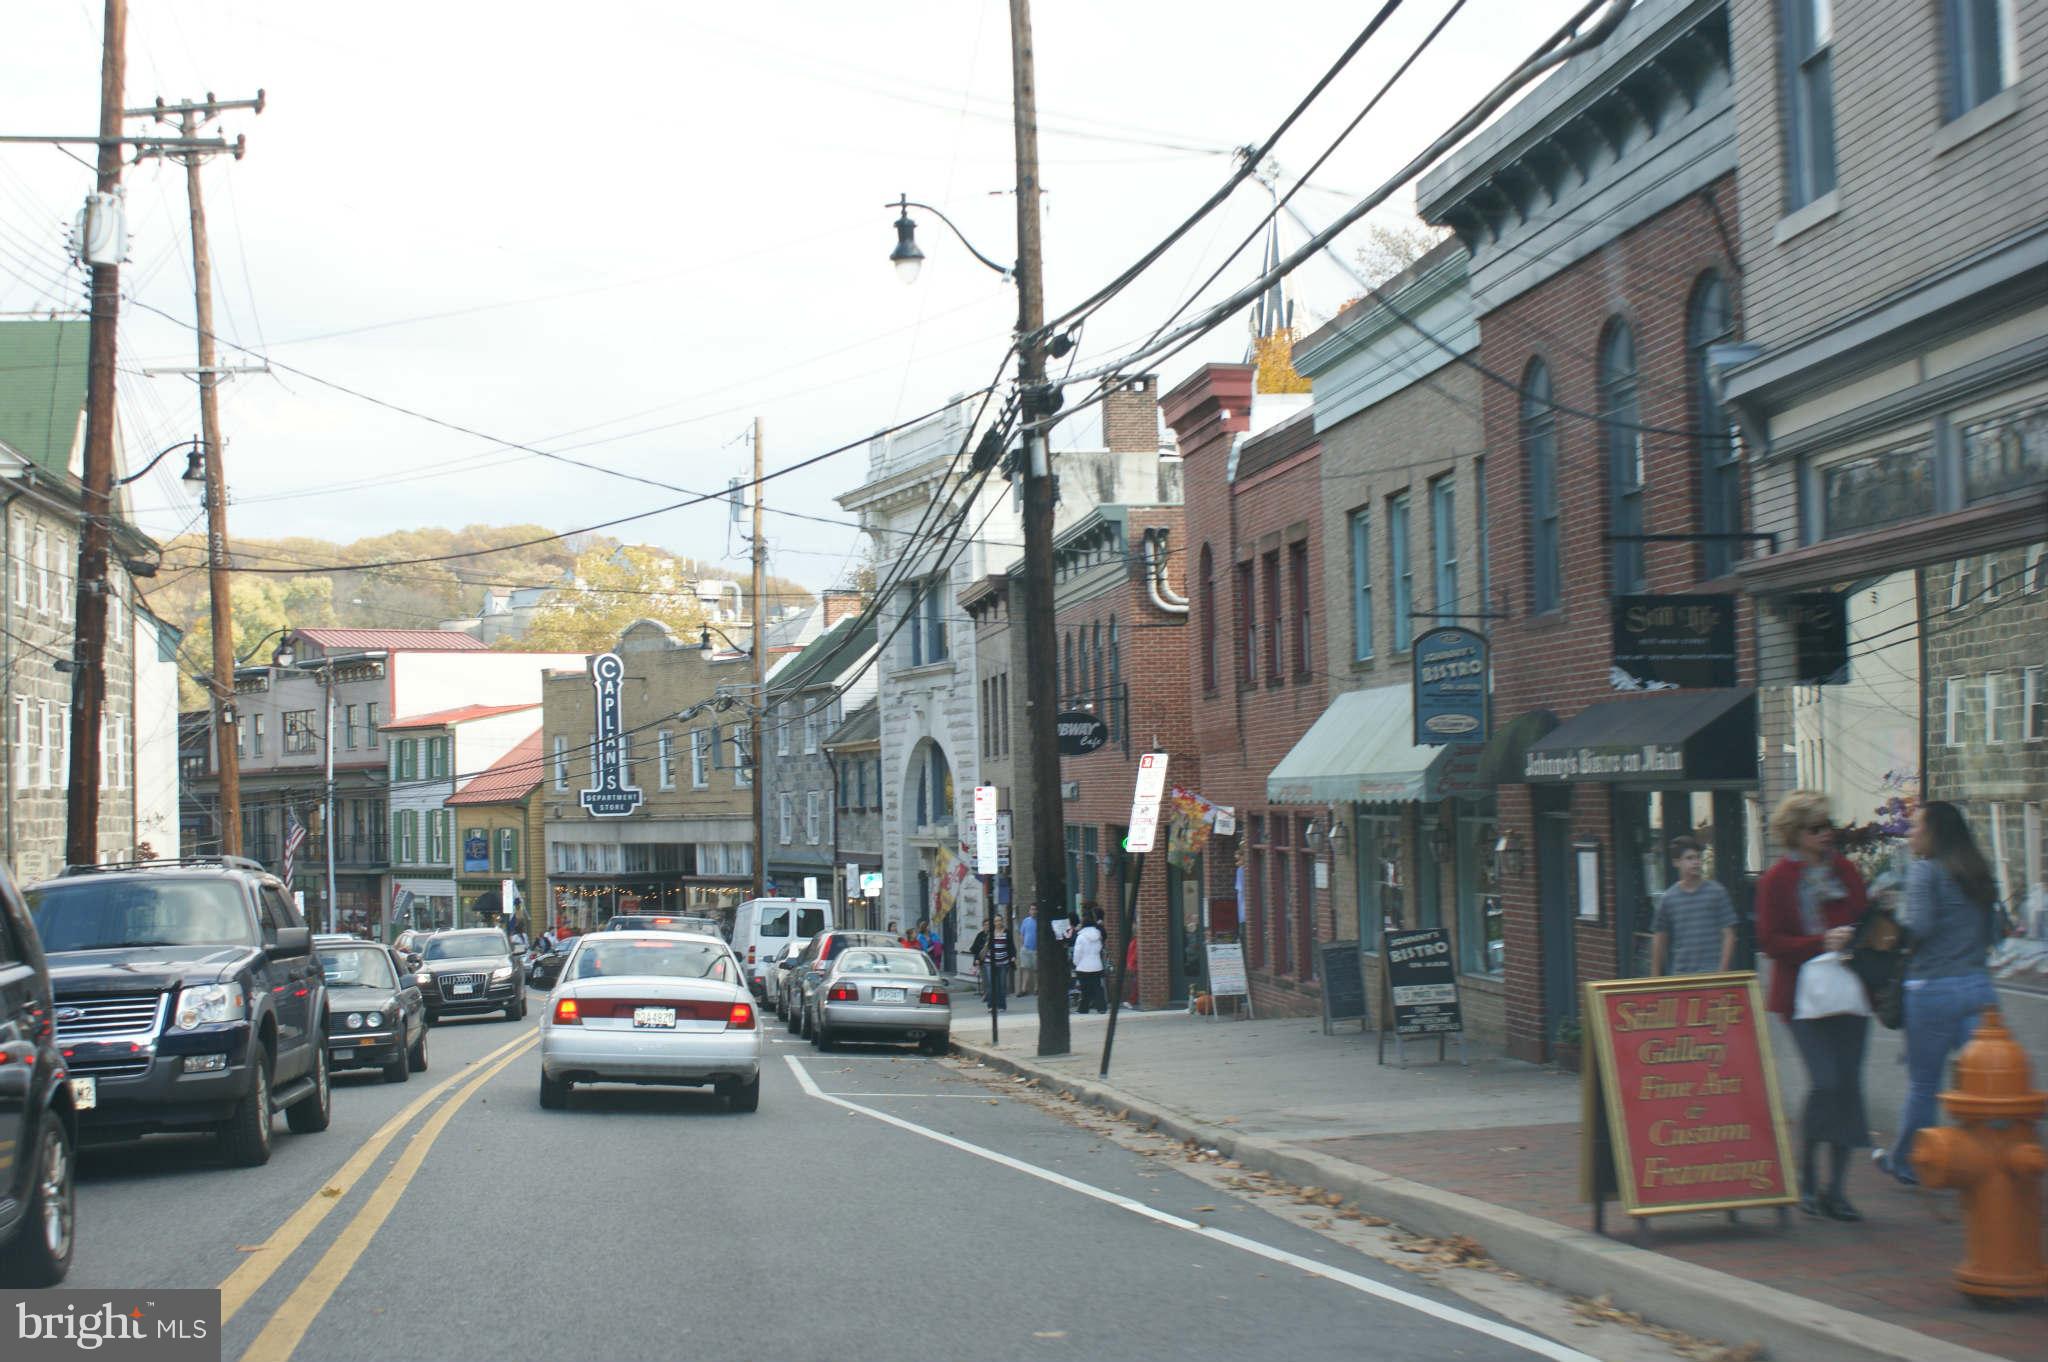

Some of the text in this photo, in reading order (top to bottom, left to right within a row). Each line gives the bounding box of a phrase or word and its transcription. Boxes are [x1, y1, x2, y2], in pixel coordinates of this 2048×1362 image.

[1422, 660, 1482, 684] BISTRO
[601, 661, 617, 790] CAPLAN'S
[1057, 722, 1100, 736] BWAY
[586, 794, 637, 802] DEPARTMENT
[600, 803, 625, 811] STORE
[1389, 941, 1449, 963] BISTRO
[1615, 993, 1745, 1036] Still Life
[1638, 1034, 1728, 1068] Gallery
[1638, 1071, 1743, 1101] Fine Art
[1650, 1119, 1751, 1147] Custom
[1641, 1153, 1776, 1190] Framing
